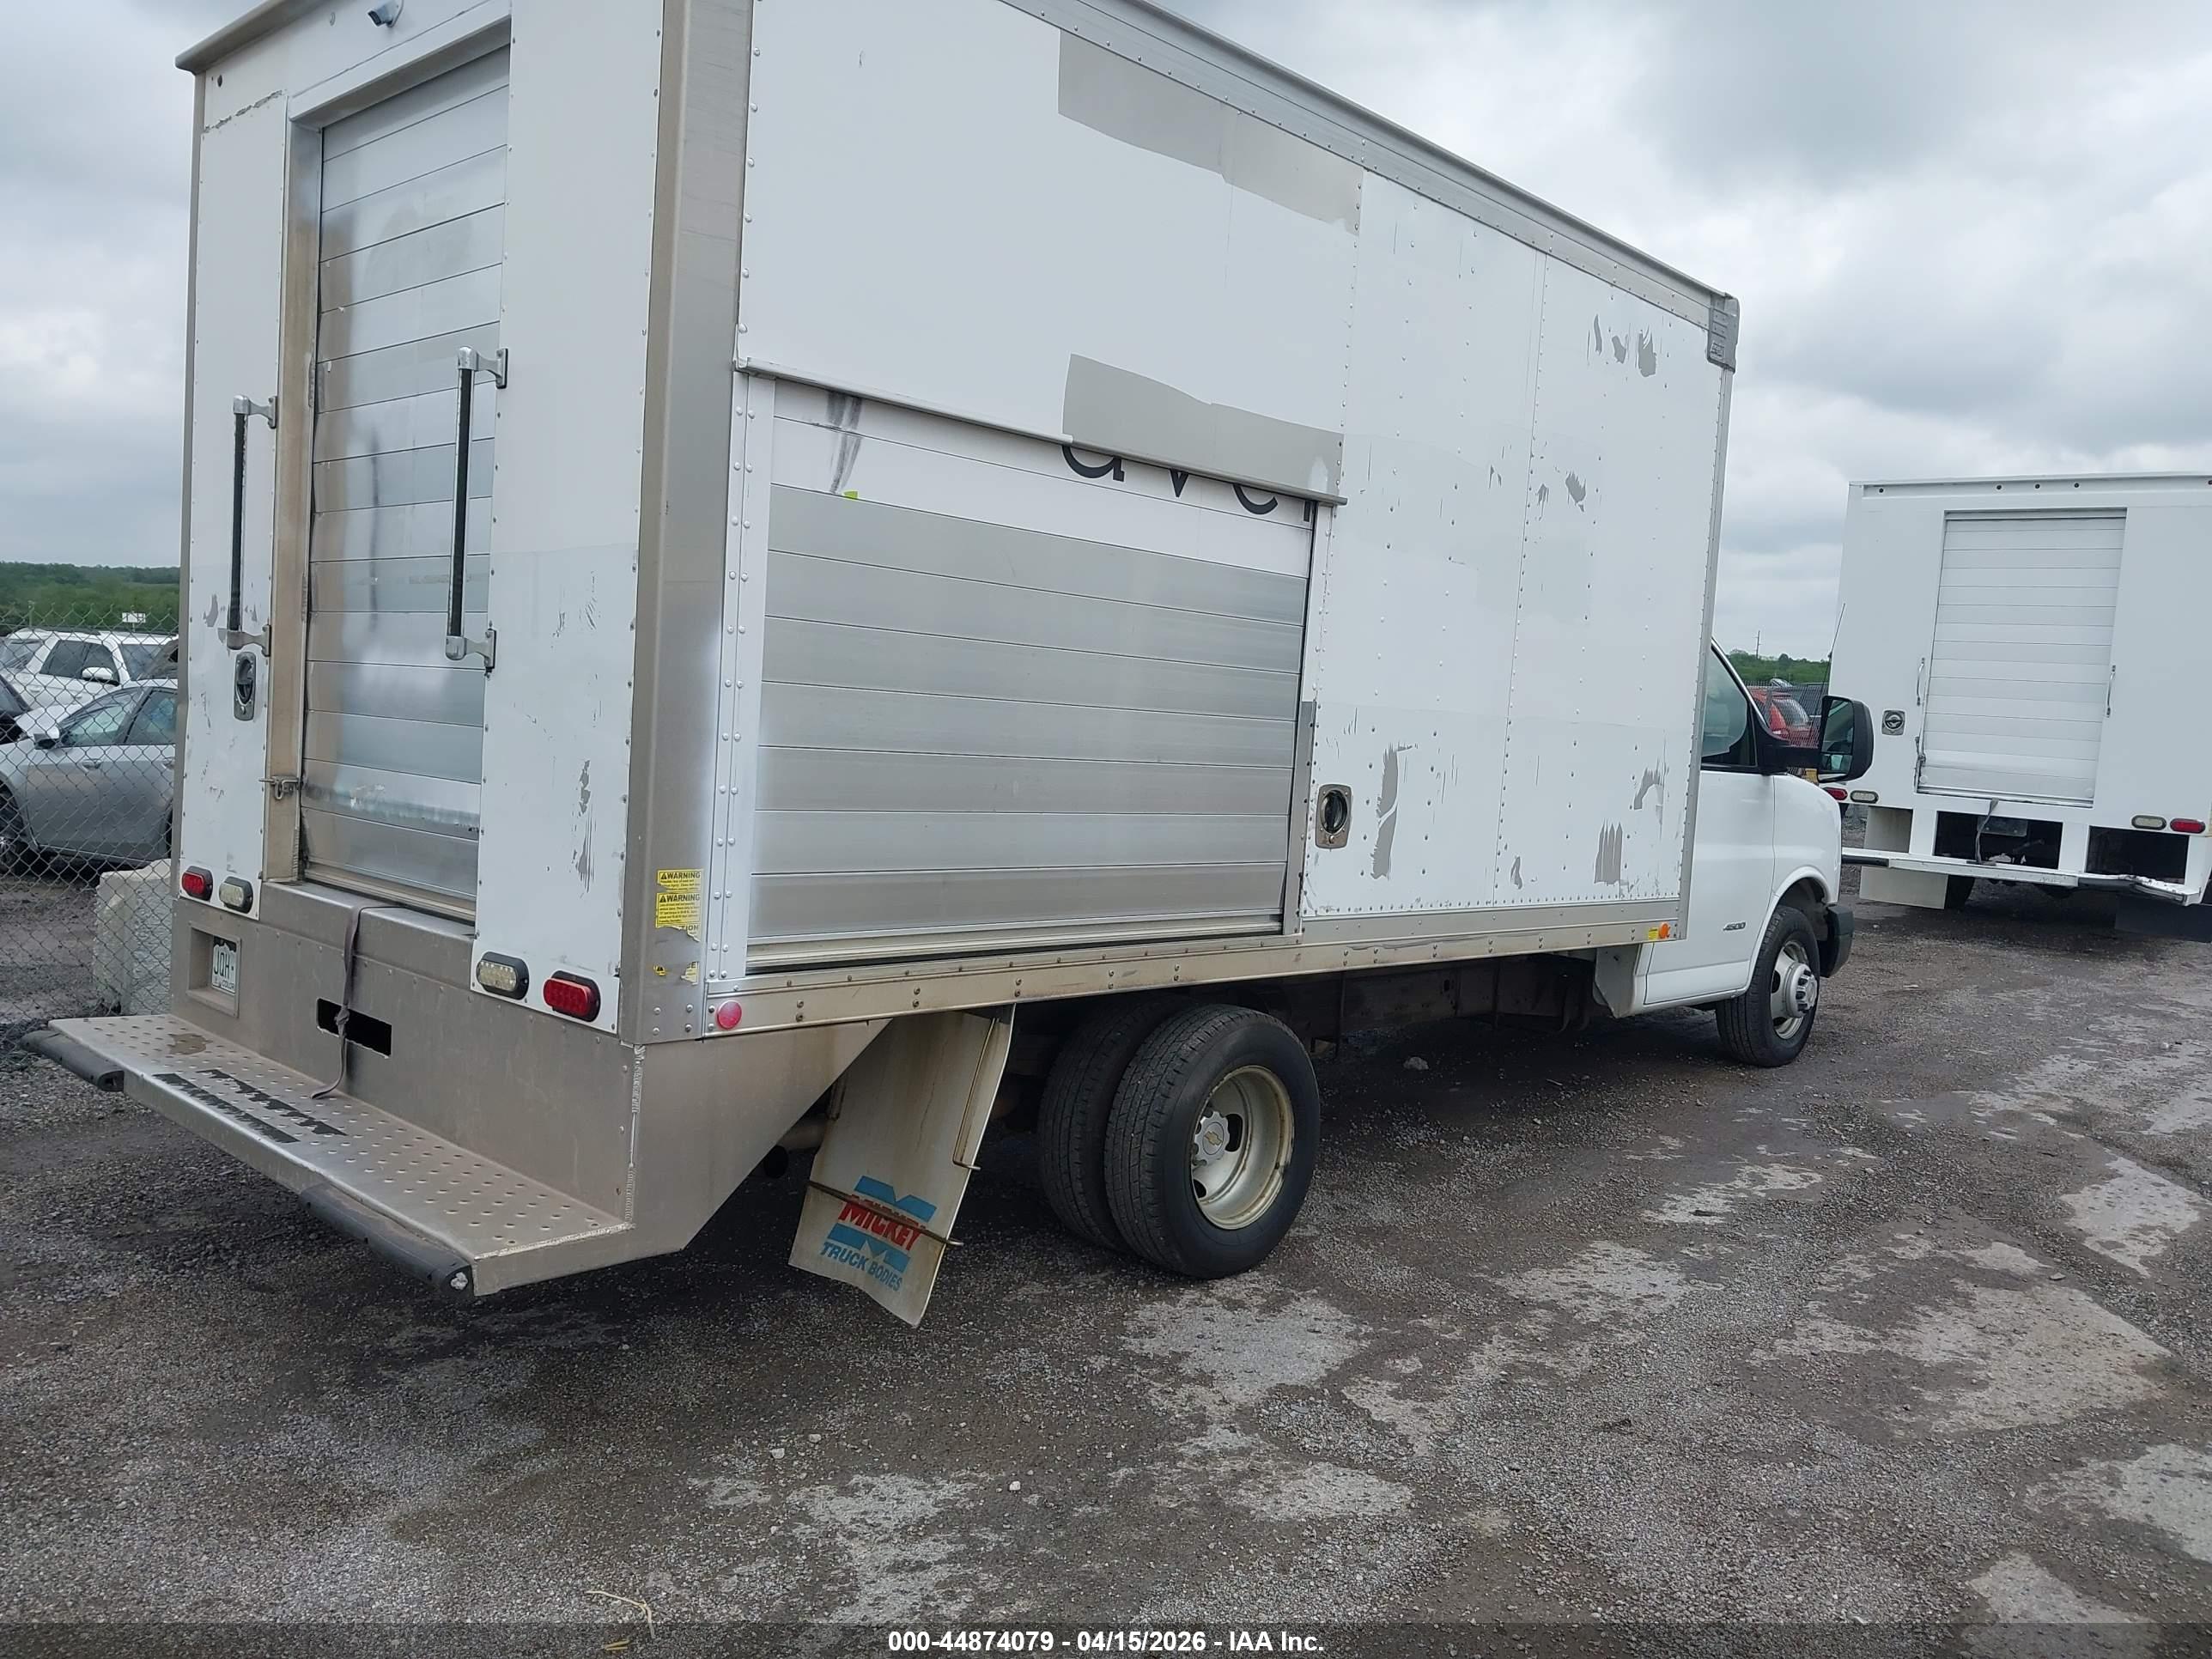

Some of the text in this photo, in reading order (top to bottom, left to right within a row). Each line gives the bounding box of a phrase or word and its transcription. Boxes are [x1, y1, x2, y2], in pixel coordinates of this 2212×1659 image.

[665, 894, 701, 902] WARNING
[838, 1194, 922, 1251] MICKEY
[819, 1241, 903, 1291] TRUCK BODIES
